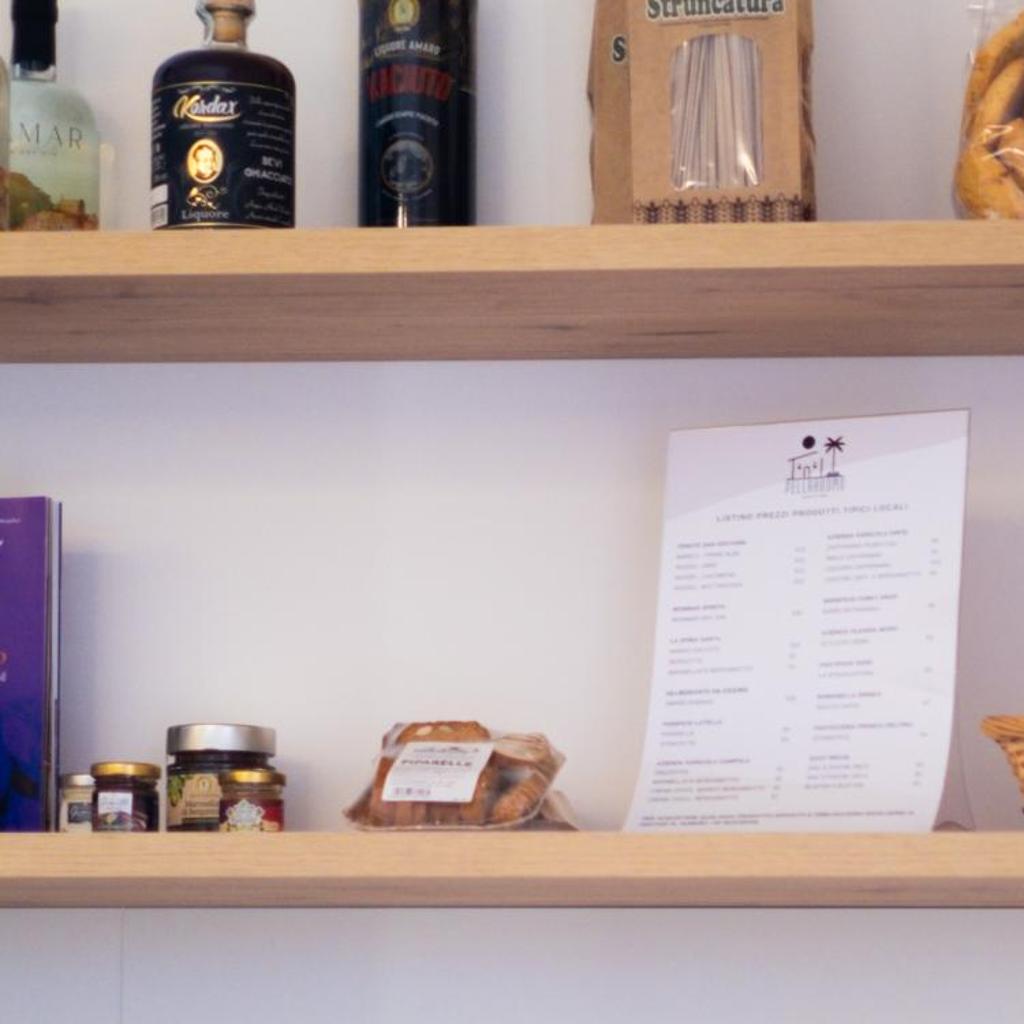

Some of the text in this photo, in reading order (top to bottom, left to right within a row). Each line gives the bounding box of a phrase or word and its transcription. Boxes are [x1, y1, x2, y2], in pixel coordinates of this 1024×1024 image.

[409, 40, 441, 56] AMARO
[181, 209, 230, 223] Liquore
[716, 512, 752, 523] LISTINO
[756, 510, 790, 520] PREZZI
[791, 507, 839, 518] PRODOTTI
[873, 503, 908, 513] LOCALI
